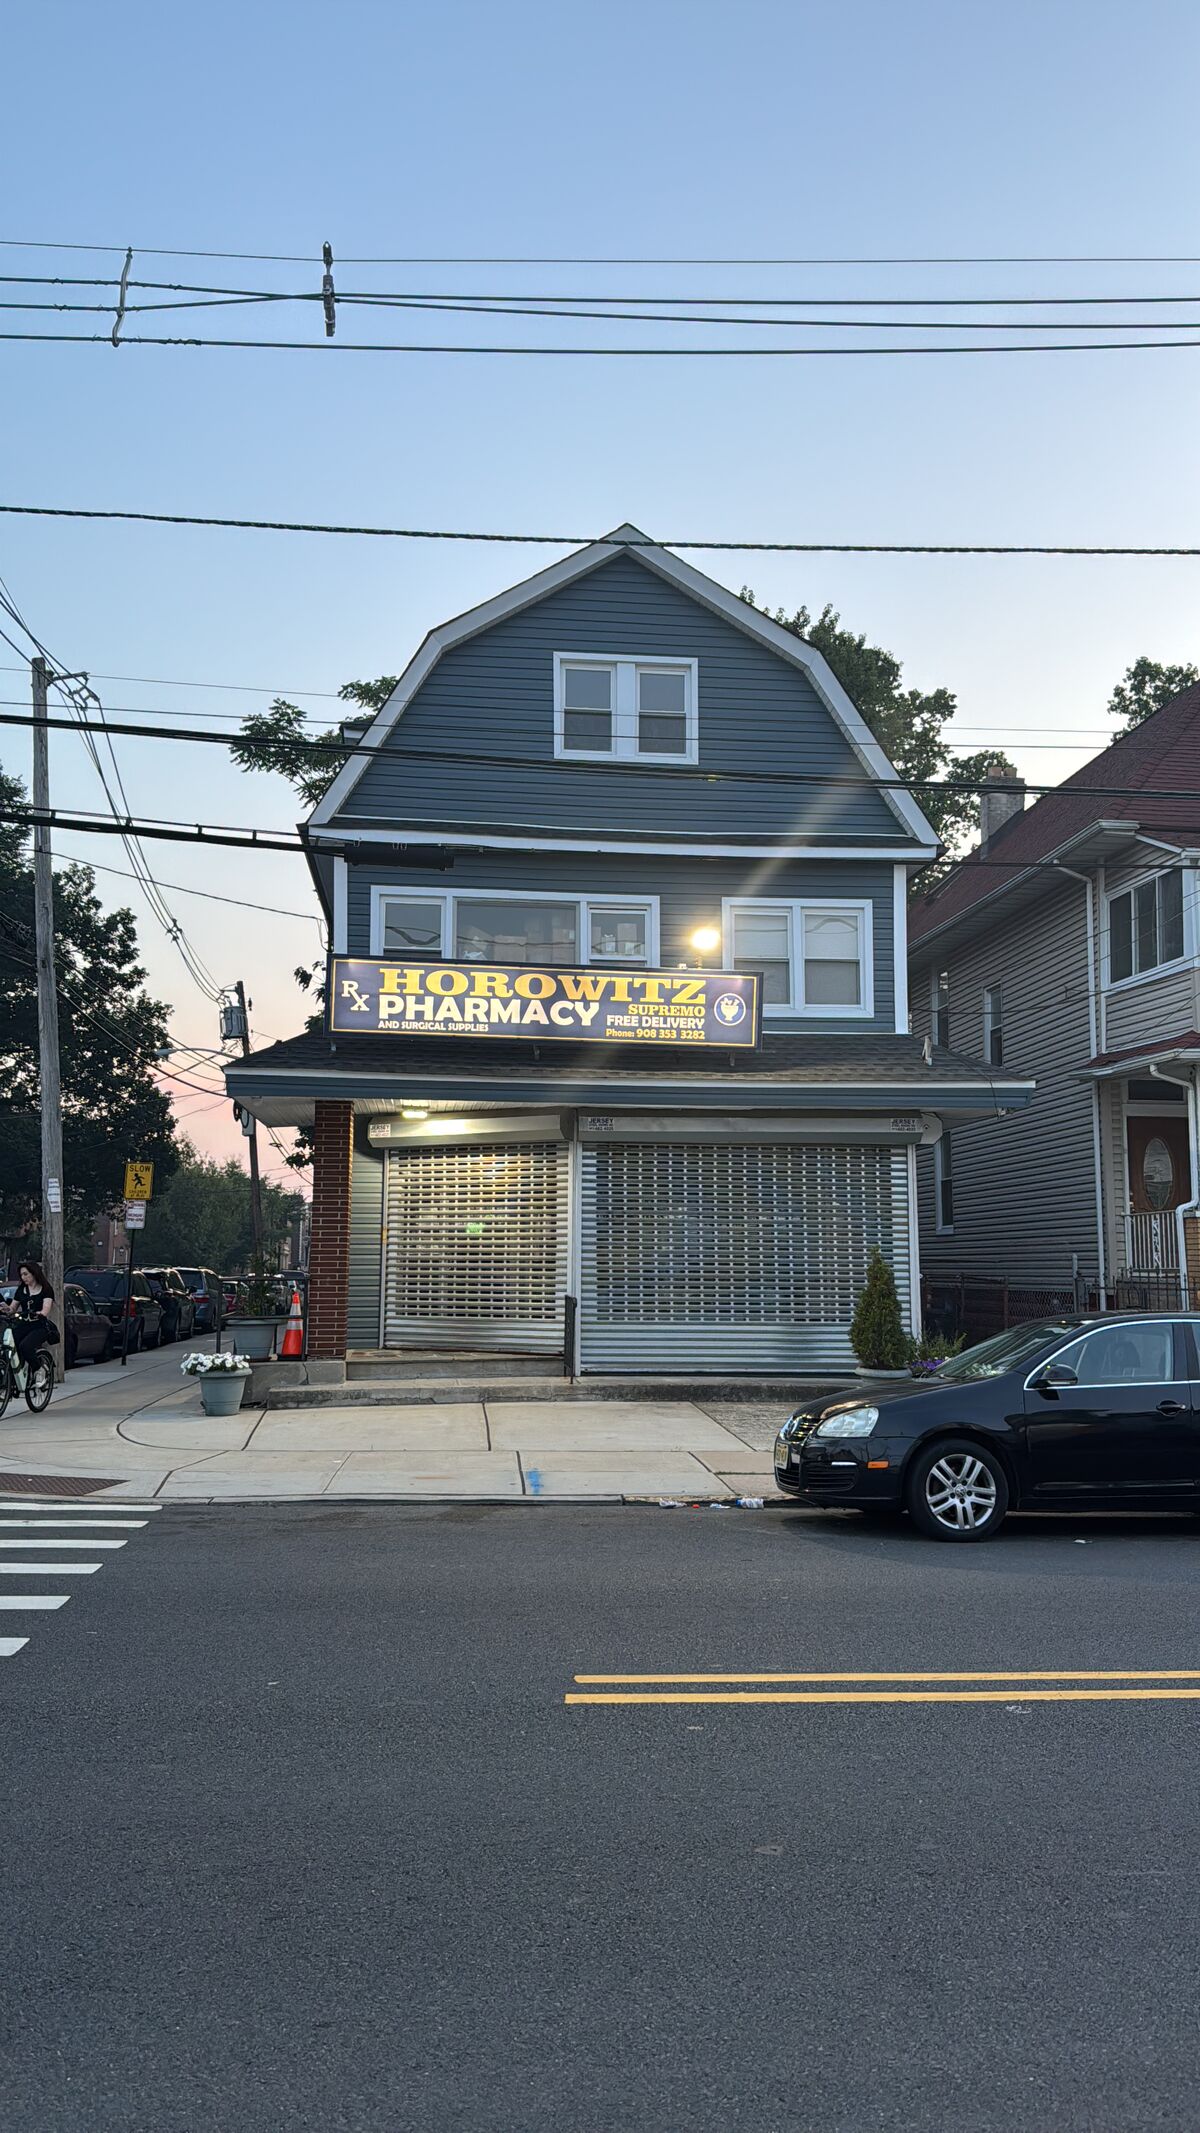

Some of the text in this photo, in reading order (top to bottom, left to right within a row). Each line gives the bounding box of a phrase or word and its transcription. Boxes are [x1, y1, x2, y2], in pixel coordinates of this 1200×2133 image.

[378, 968, 706, 1004] HOROWITZ
[378, 994, 600, 1027] PHARMACY
[628, 1004, 705, 1017] SUPREMO
[378, 1020, 489, 1033] AND SURGICAL SUPPLIES
[606, 1014, 705, 1029] FREE DELIVERY
[605, 1028, 705, 1040] Phone: 908 353 3282
[129, 1164, 151, 1173] SLOW
